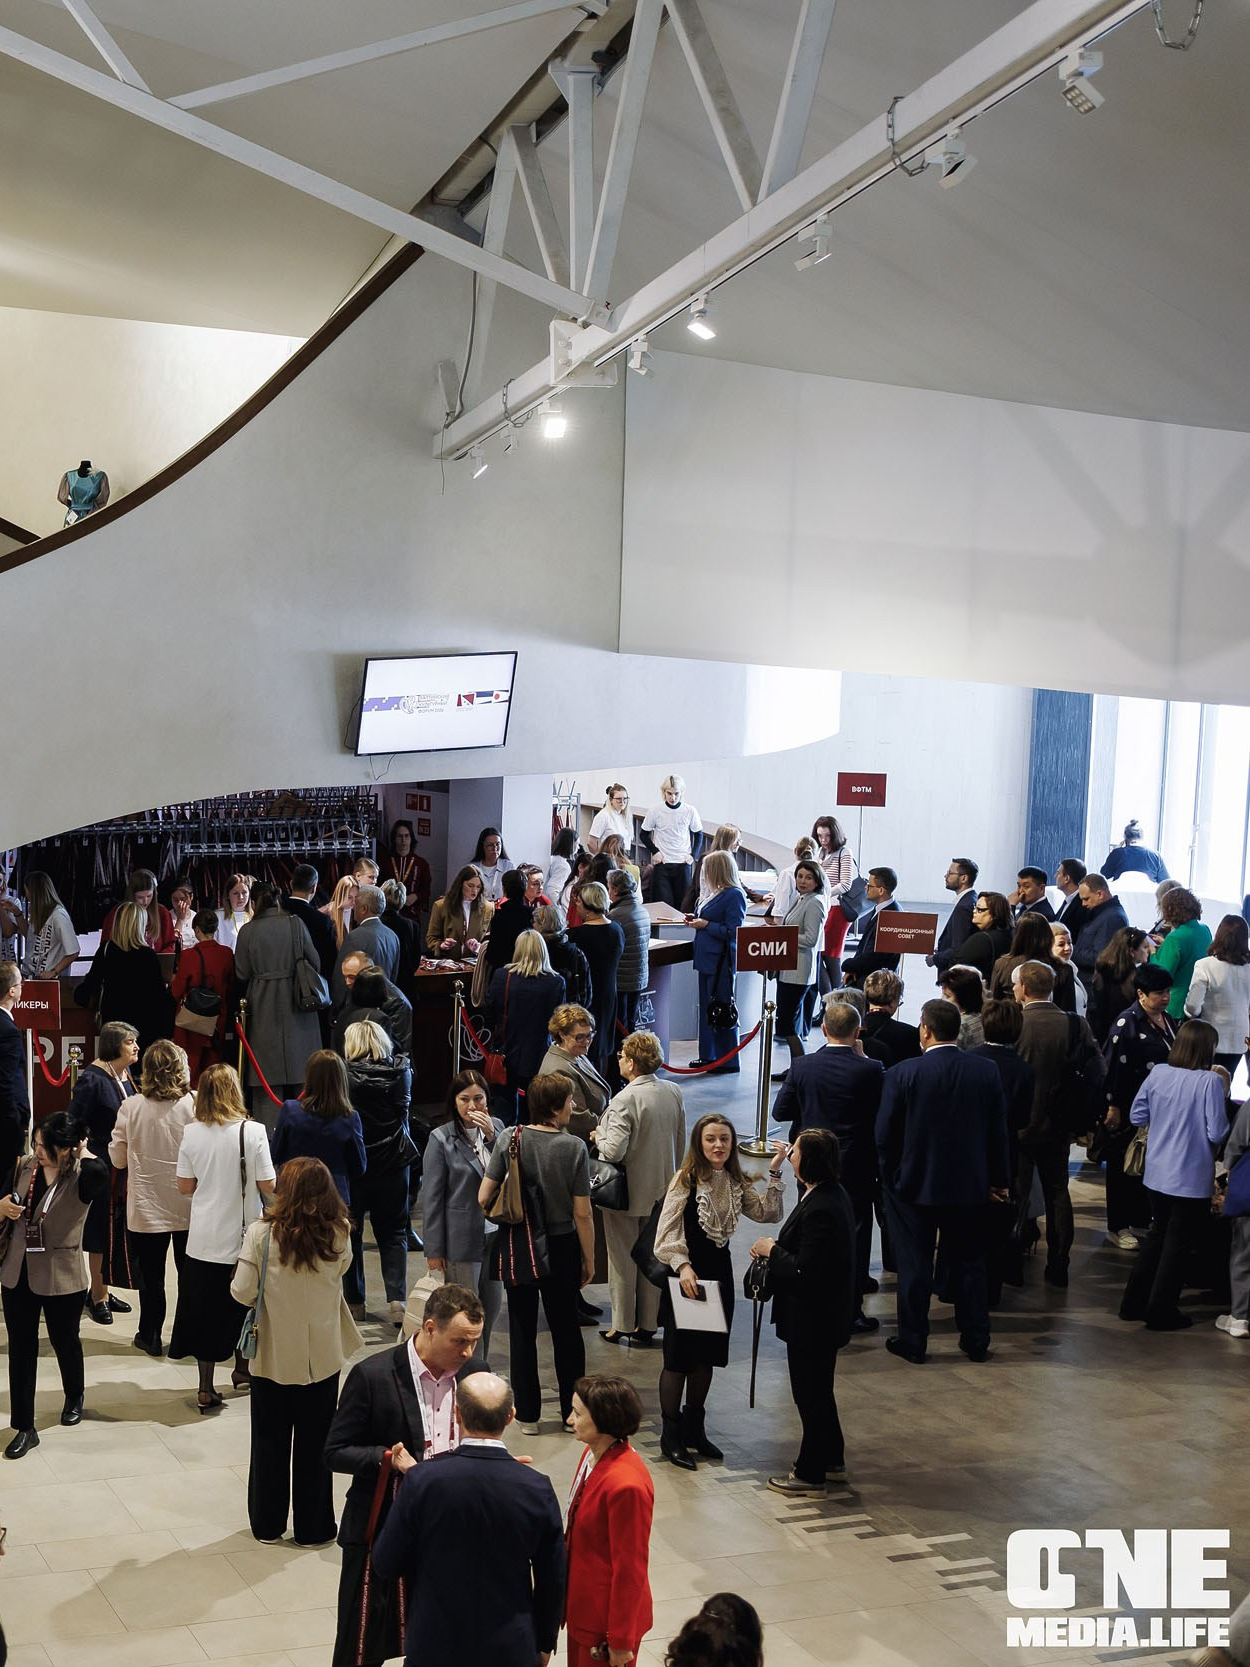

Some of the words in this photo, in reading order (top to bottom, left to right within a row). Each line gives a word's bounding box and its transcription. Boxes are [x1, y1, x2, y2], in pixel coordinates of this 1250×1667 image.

[879, 926, 935, 935] КООРДИНАЦИОННЫЙ
[747, 941, 788, 957] СМИ
[14, 1000, 49, 1009] ИКЕРЫ
